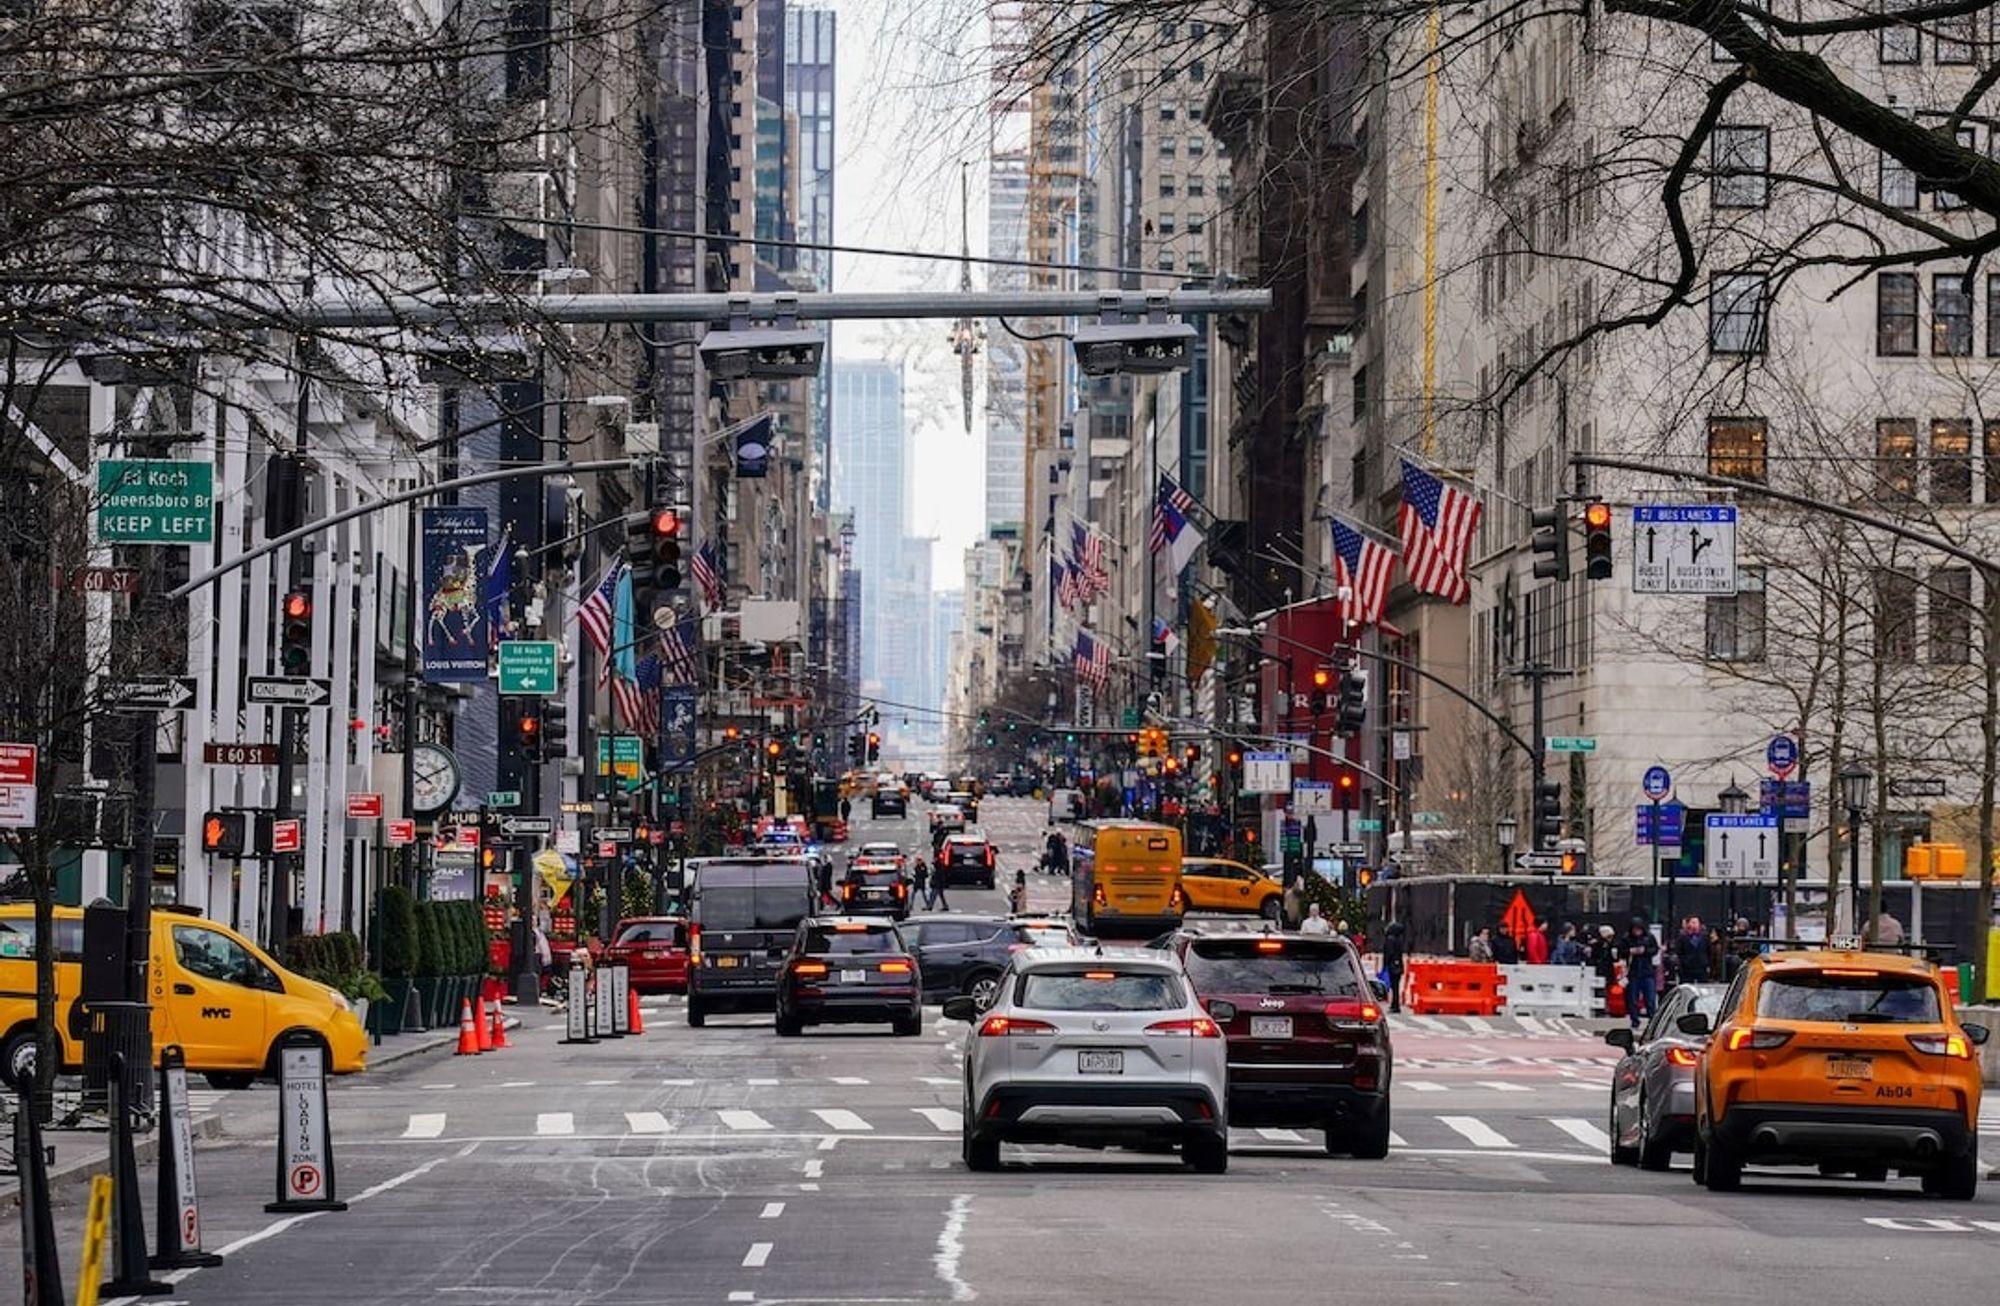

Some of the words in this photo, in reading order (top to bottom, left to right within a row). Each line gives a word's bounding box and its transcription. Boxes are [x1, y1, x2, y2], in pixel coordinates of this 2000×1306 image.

[149, 470, 188, 486] Koch
[100, 494, 189, 509] Queensboro
[195, 495, 211, 508] Br
[1658, 508, 1679, 521] BUS
[1681, 508, 1714, 521] LANES
[103, 516, 152, 533] KEEP
[162, 517, 206, 533] LEFT
[84, 572, 104, 591] 60
[111, 572, 130, 591] ST
[426, 660, 450, 669] LOUIS
[451, 660, 486, 669] VUITTON
[256, 684, 279, 697] ONE
[295, 685, 318, 698] WAY
[216, 748, 224, 762] E
[228, 748, 245, 762] 60
[249, 748, 262, 762] St
[449, 813, 502, 824] HUBOT
[1259, 998, 1285, 1009] Jeep
[202, 1007, 232, 1019] NYC
[287, 1082, 317, 1091] HOTEL
[298, 1092, 310, 1152] LOADING
[291, 1153, 318, 1163] ZONE
